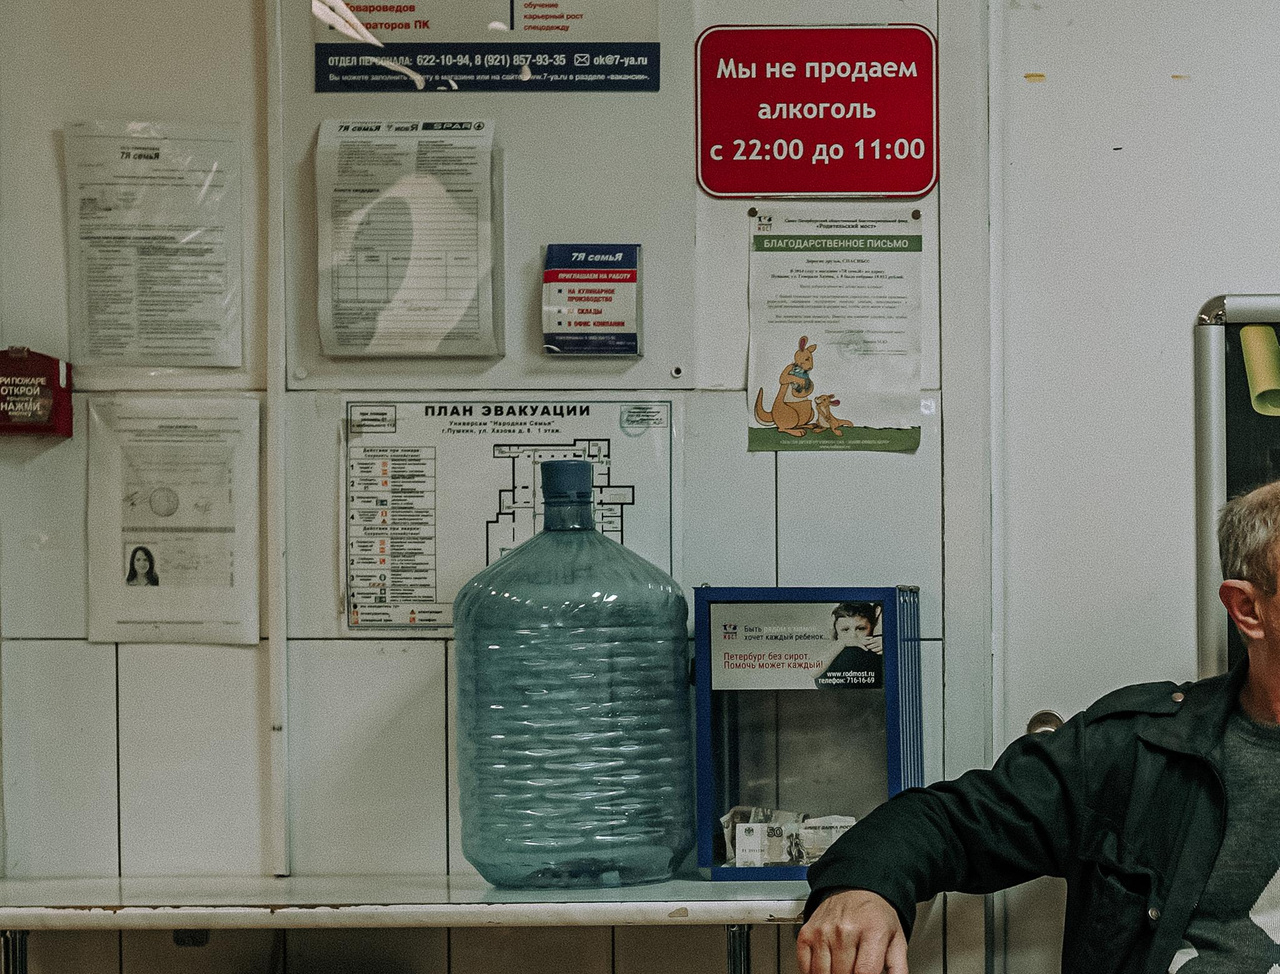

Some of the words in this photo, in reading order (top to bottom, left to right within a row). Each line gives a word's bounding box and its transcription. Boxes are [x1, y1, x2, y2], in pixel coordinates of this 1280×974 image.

[345, 3, 416, 13] овароведов
[523, 12, 564, 20] карьерный
[365, 20, 411, 30] раторов
[414, 20, 430, 29] ПК
[523, 24, 570, 32] спецодежду
[328, 56, 357, 67] ОТДЕЛ
[416, 54, 472, 67] 622-10-94,
[474, 55, 482, 66] 8
[484, 54, 510, 67] (921)
[512, 54, 566, 66] 857-93-35
[594, 54, 648, 67] ok@7-ya.ru
[716, 58, 756, 79] Мы
[766, 62, 796, 78] не
[805, 61, 918, 84] продаем
[757, 102, 876, 120] алкоголь
[434, 122, 472, 130] SPAR
[710, 143, 724, 160] с
[732, 138, 804, 161] 22:00
[812, 142, 844, 164] до
[854, 138, 926, 160] 11:00
[764, 240, 864, 248] БЛАГОДАРСТВЕННОЕ
[867, 239, 909, 248] ПИСЬМО
[571, 252, 586, 261] 7Я
[587, 252, 623, 261] семьЯ
[0, 376, 10, 384] РИ
[11, 377, 46, 385] ПОЖАРЕ
[0, 386, 40, 395] ОТКРОЙ
[0, 402, 40, 411] НАЖМИ
[424, 406, 474, 416] ПЛАН
[481, 406, 590, 418] ЭВАКУАЦИИ
[723, 652, 765, 662] Петербург
[768, 652, 782, 660] без
[784, 653, 810, 661] сирот.
[723, 661, 756, 669] Помочь
[788, 661, 824, 670] каждый!
[767, 826, 783, 838] 50
